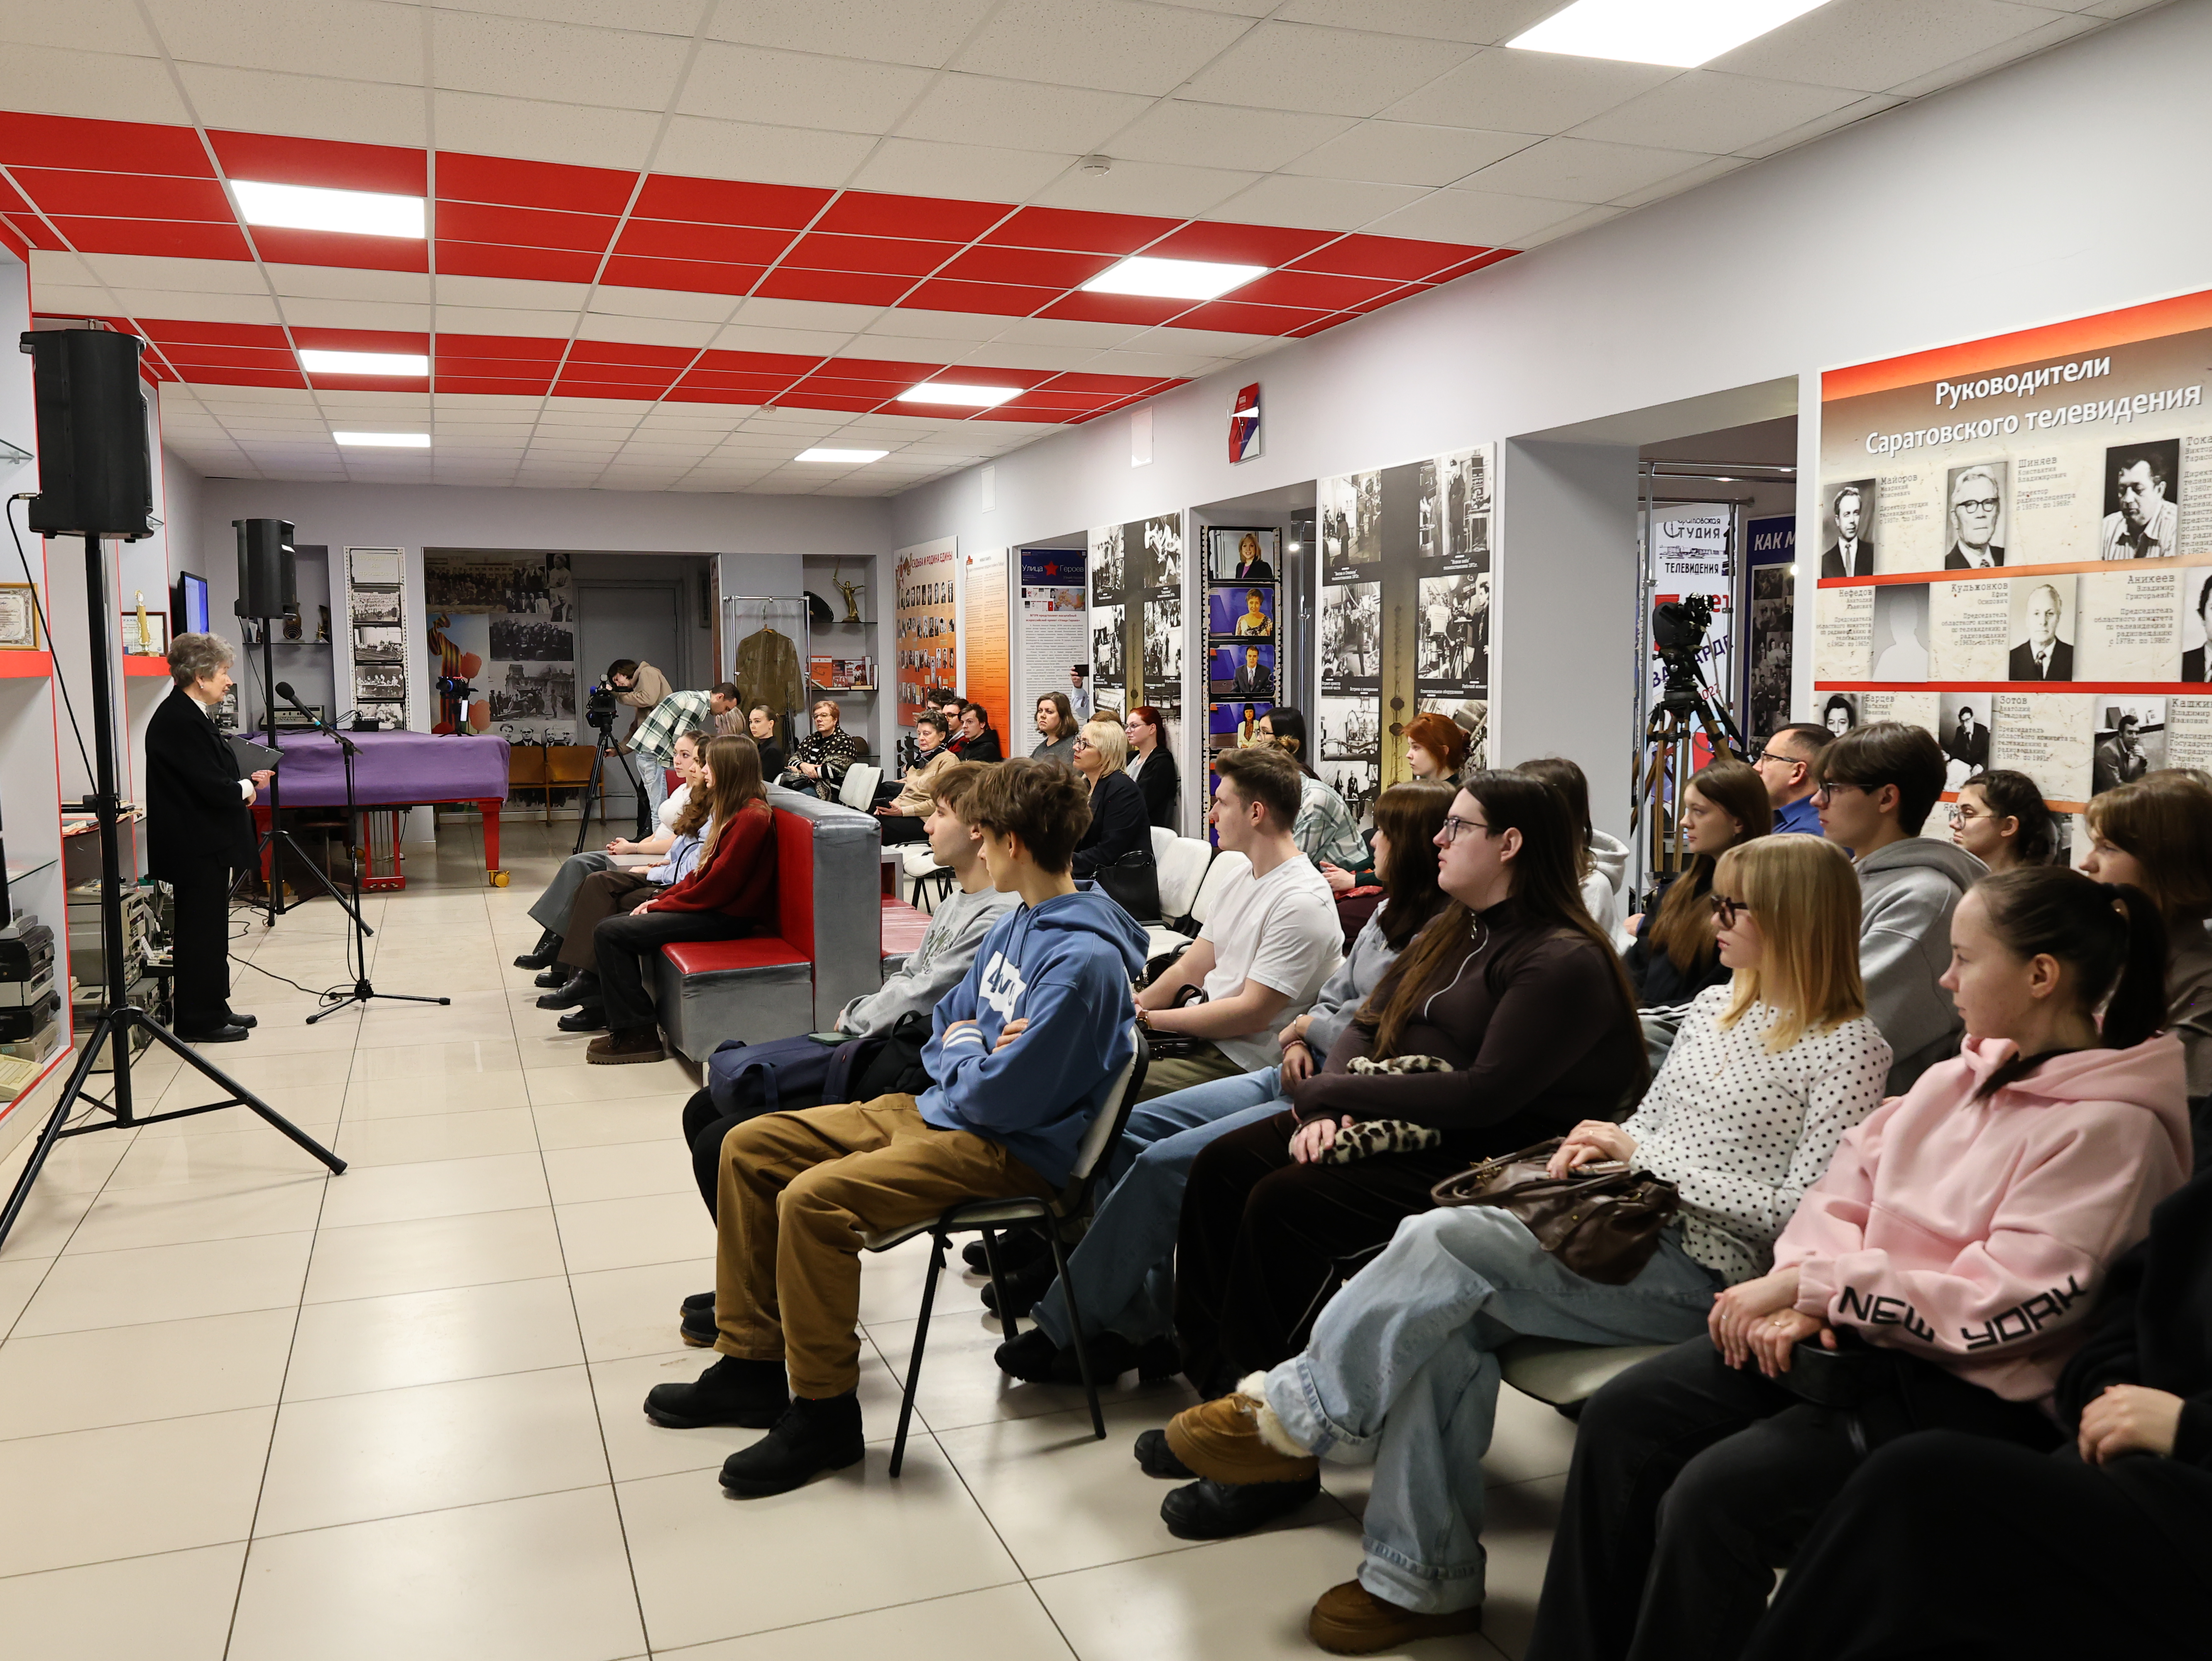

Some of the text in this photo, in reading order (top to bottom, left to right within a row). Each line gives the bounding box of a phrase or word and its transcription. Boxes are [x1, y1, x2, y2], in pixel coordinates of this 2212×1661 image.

[1936, 356, 2111, 409] Руководители
[1865, 385, 2202, 457] Саратовского телевидения
[2018, 457, 2057, 468] Шиняев
[2018, 467, 2056, 475] Константин
[1881, 475, 1918, 485] Майоров
[2017, 473, 2067, 483] Владимирович
[1754, 532, 1784, 551] КАК
[912, 551, 952, 568] СУДЬБА И РОДИНА ЕДИНЫ
[1665, 563, 1719, 574] ТЕЛЕВИДЕНИЯ
[2127, 575, 2175, 584] Аникеев
[1951, 583, 2008, 593] Кульжонков
[1839, 589, 1872, 598] Нефедов
[1865, 694, 1894, 703] Барцев
[1999, 696, 2027, 704] Зотов
[2171, 698, 2212, 708] Кашки
[1839, 1275, 2087, 1350] NEW YORK
